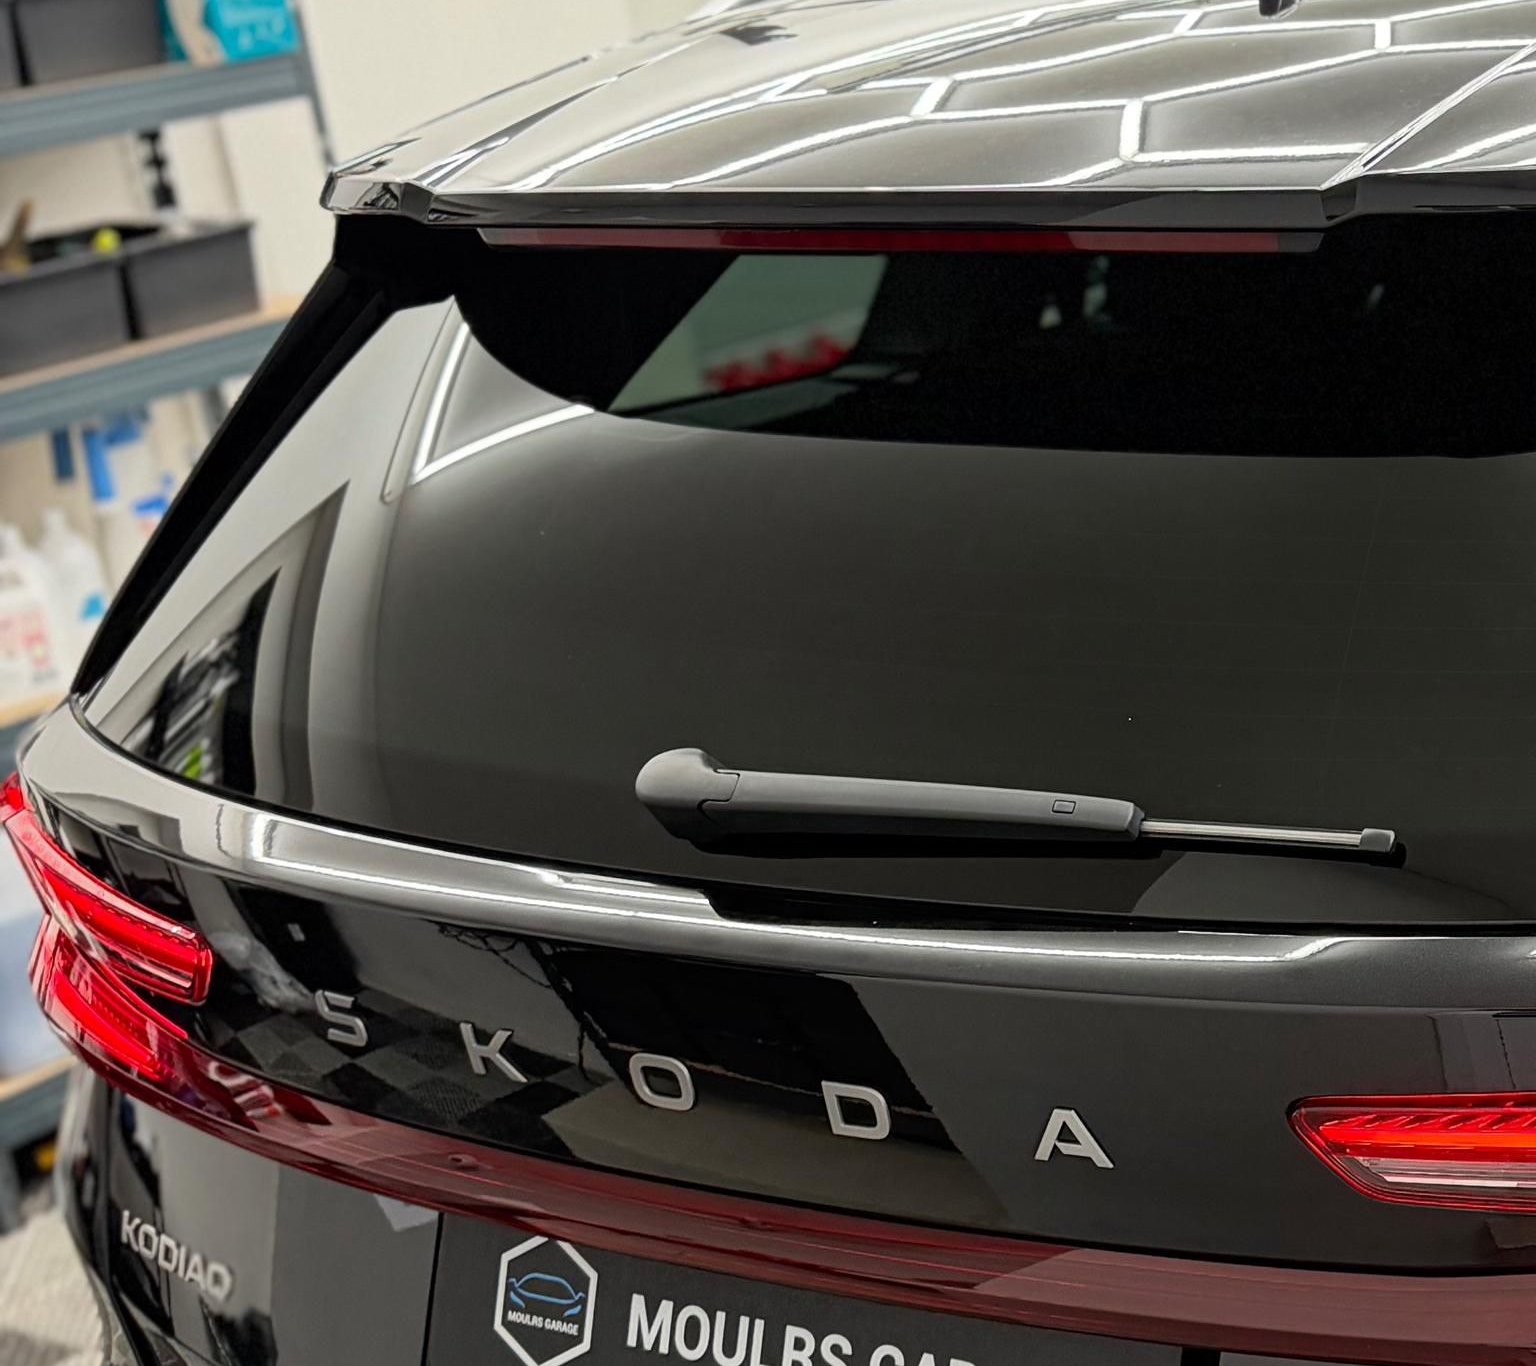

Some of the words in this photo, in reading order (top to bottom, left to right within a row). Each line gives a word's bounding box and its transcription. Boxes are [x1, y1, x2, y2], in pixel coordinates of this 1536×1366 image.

[121, 1209, 233, 1303] KODIAQ
[507, 1310, 543, 1328] MOULRS
[544, 1318, 579, 1336] GARAGE
